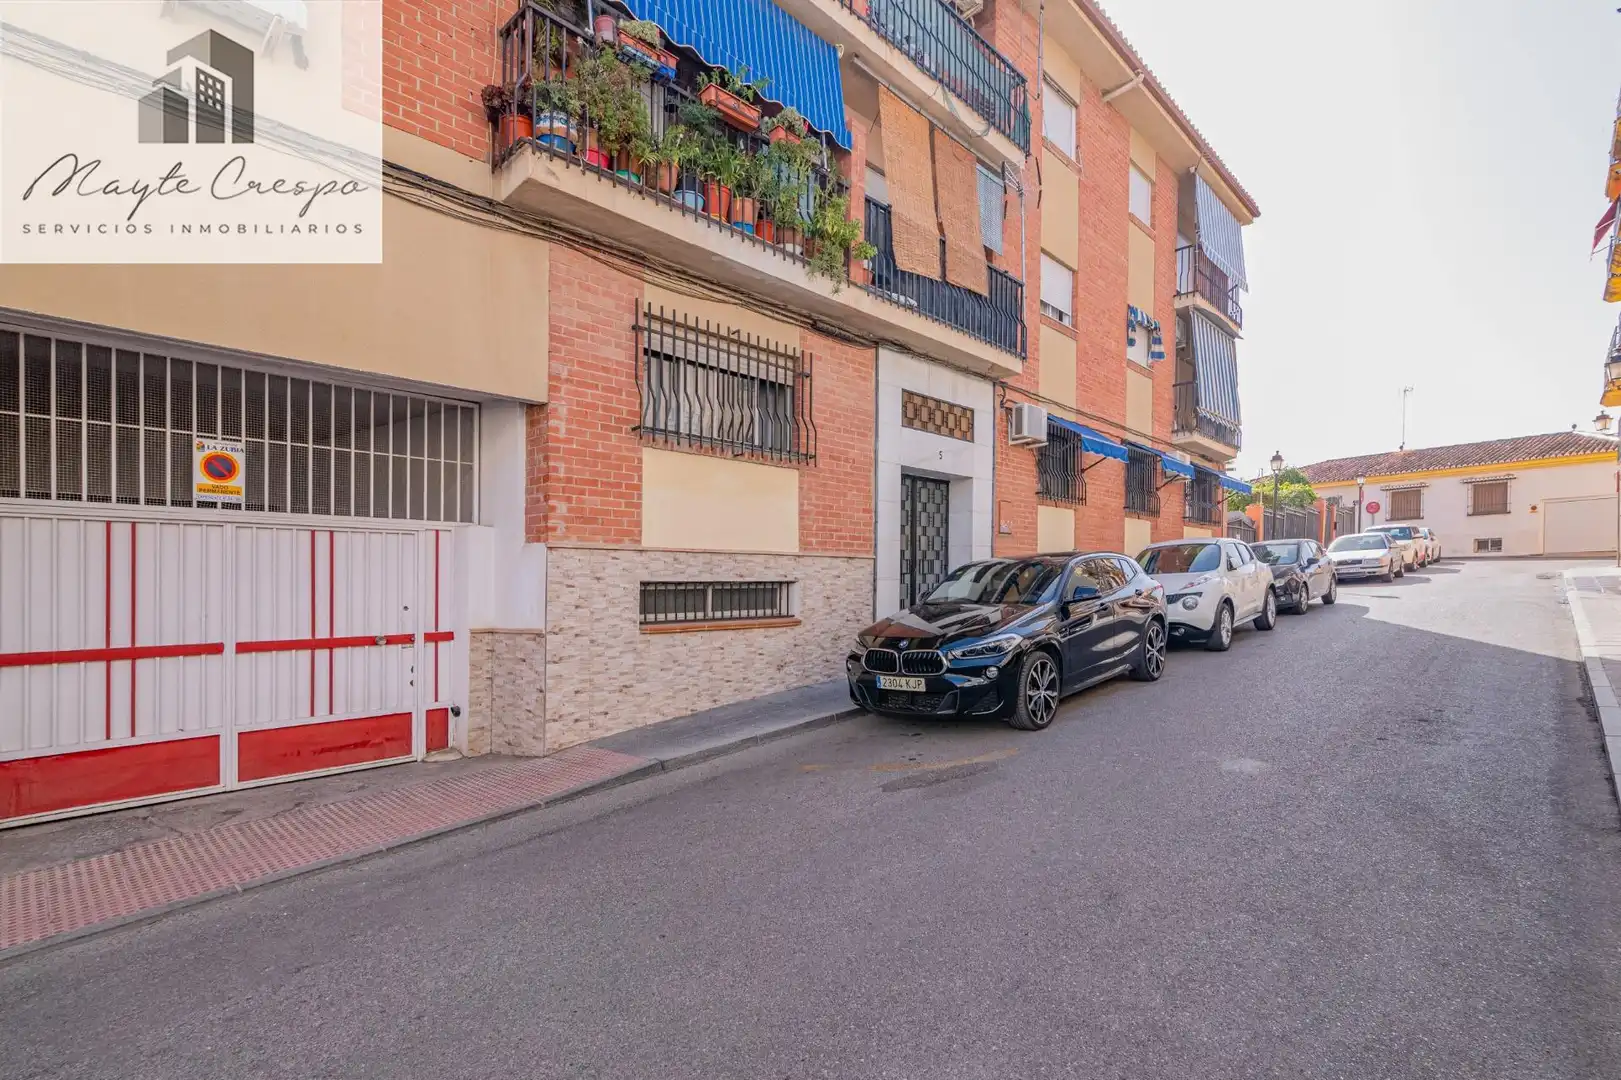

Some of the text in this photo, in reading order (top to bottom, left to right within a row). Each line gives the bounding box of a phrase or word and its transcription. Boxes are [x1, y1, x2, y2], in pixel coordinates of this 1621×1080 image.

[939, 450, 943, 460] 5
[882, 678, 923, 689] 2304 KJP
